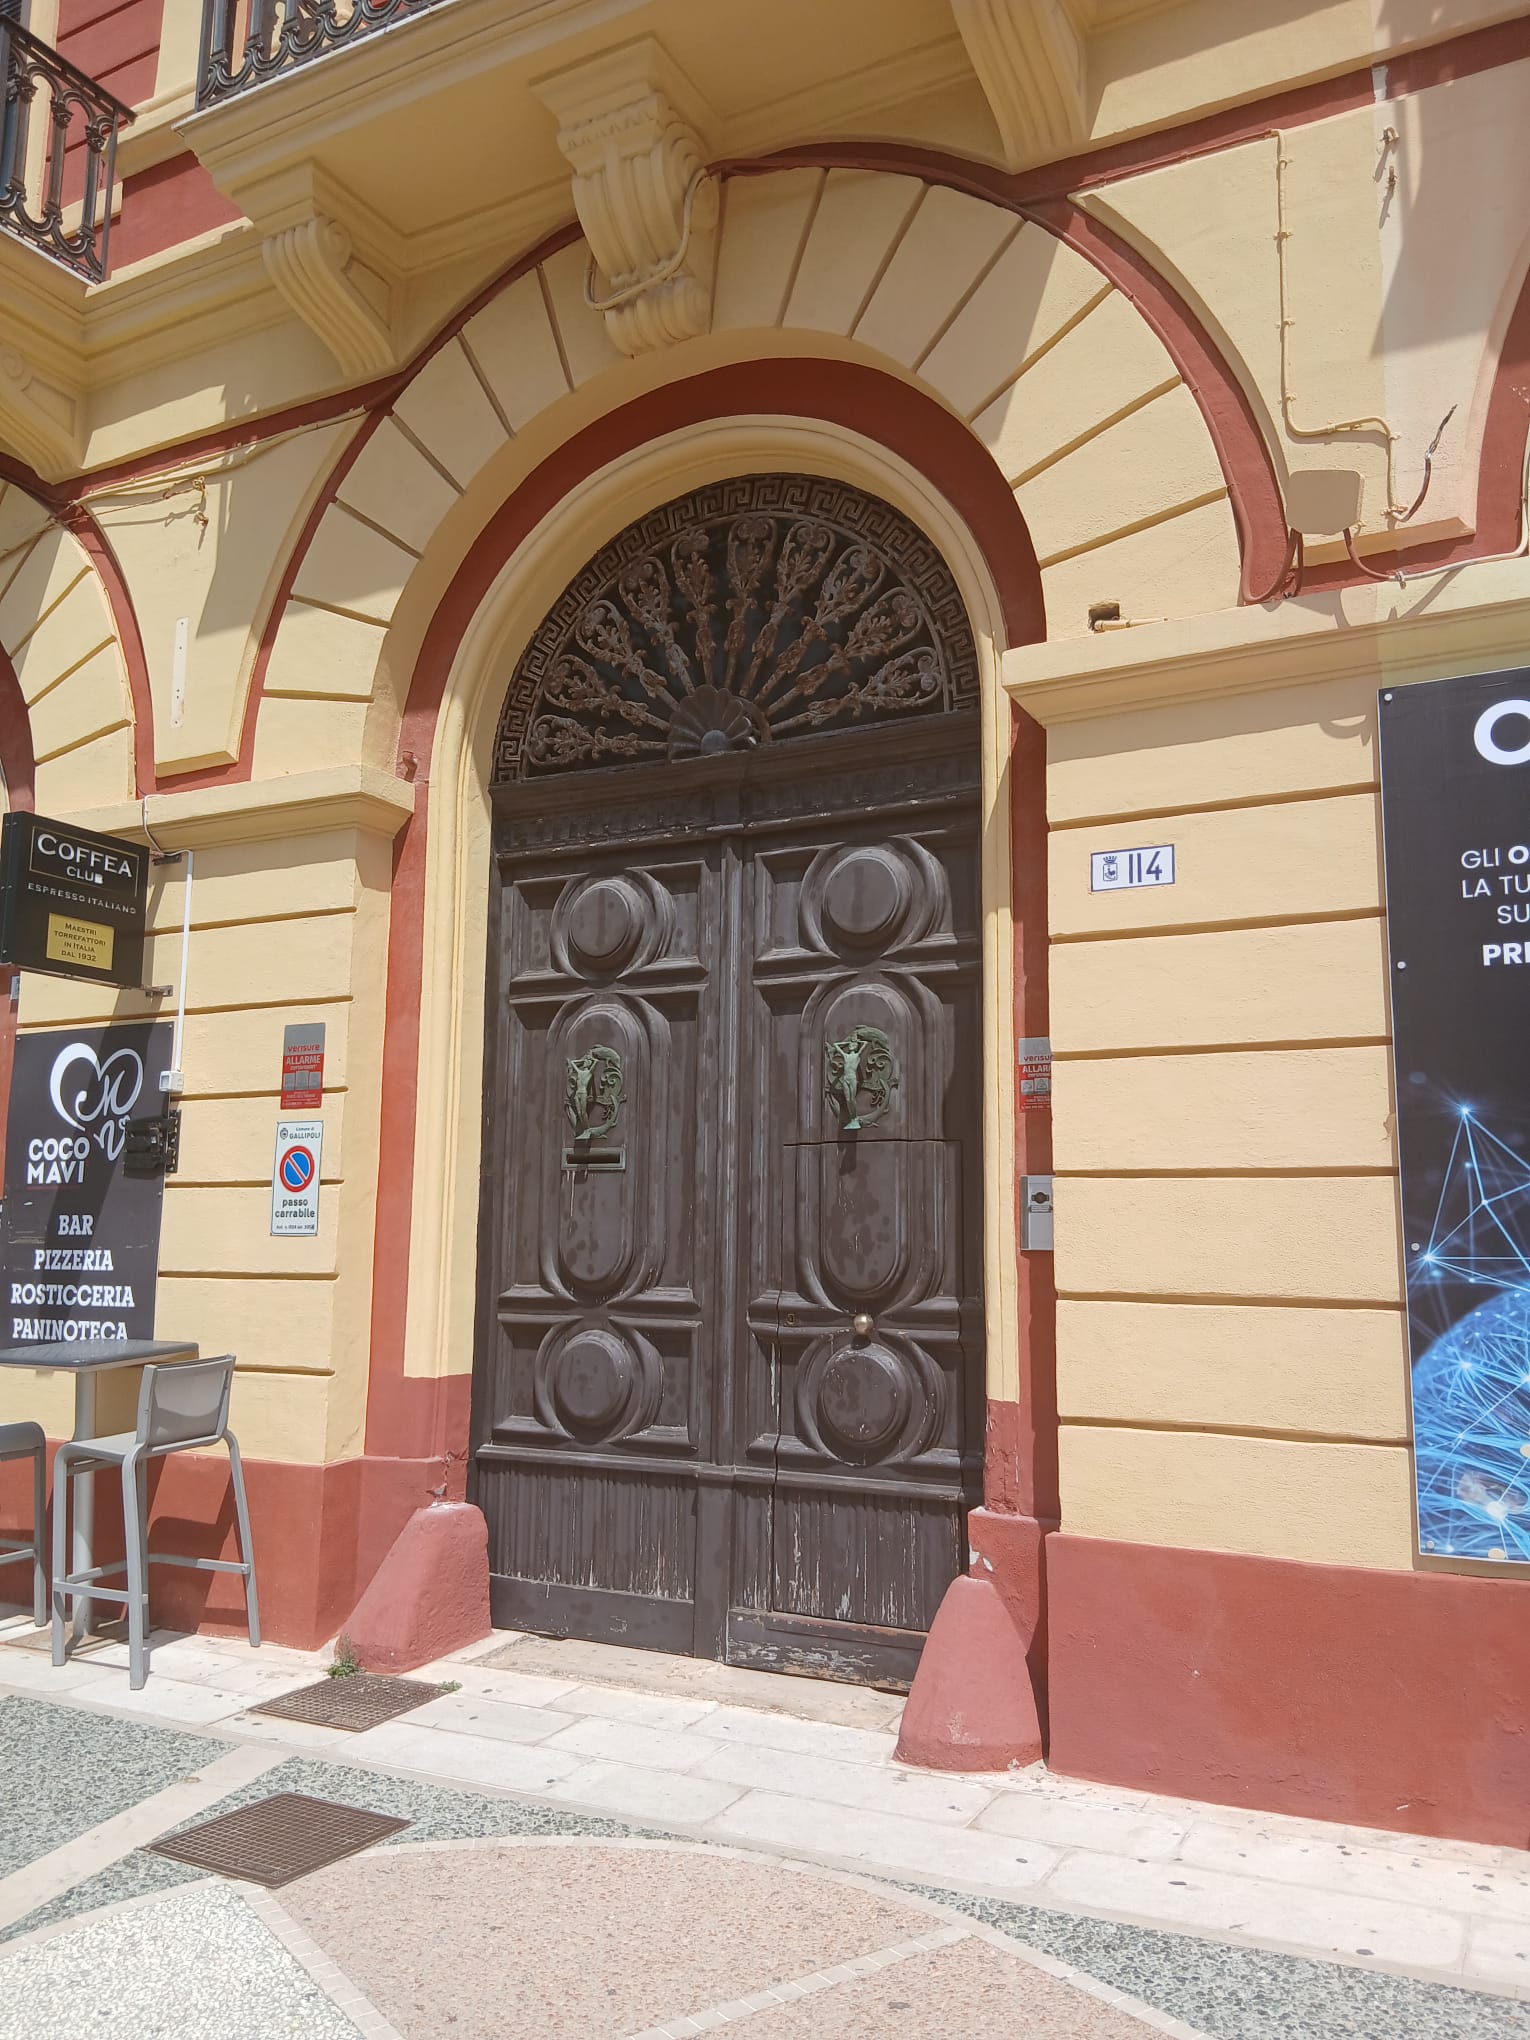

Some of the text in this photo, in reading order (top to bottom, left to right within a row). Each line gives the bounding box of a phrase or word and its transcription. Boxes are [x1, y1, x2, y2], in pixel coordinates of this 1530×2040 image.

[37, 833, 132, 878] COFFEA
[1461, 847, 1500, 869] GLI
[66, 865, 103, 885] CLUB
[1128, 850, 1163, 884] 114
[1461, 873, 1530, 899] LA TU
[27, 882, 137, 915] ESPRESSO ITALIANO
[1496, 903, 1530, 925] SU
[54, 930, 106, 947] TORREFATTORI
[64, 922, 97, 936] MAESTRI
[61, 950, 97, 962] DAL 1932
[64, 941, 96, 953] IN ITALIA
[286, 1054, 321, 1065] ALLARME
[289, 1131, 321, 1140] GALLIPOLI
[28, 1136, 90, 1162] COCO
[27, 1160, 86, 1185] MAVI
[274, 1208, 316, 1219] carrabile
[282, 1199, 309, 1209] passo
[58, 1214, 94, 1236] BAR
[33, 1249, 114, 1271] PIZZERIA
[10, 1283, 136, 1308] ROSTICCERIA
[12, 1317, 128, 1341] PANINOTECA
